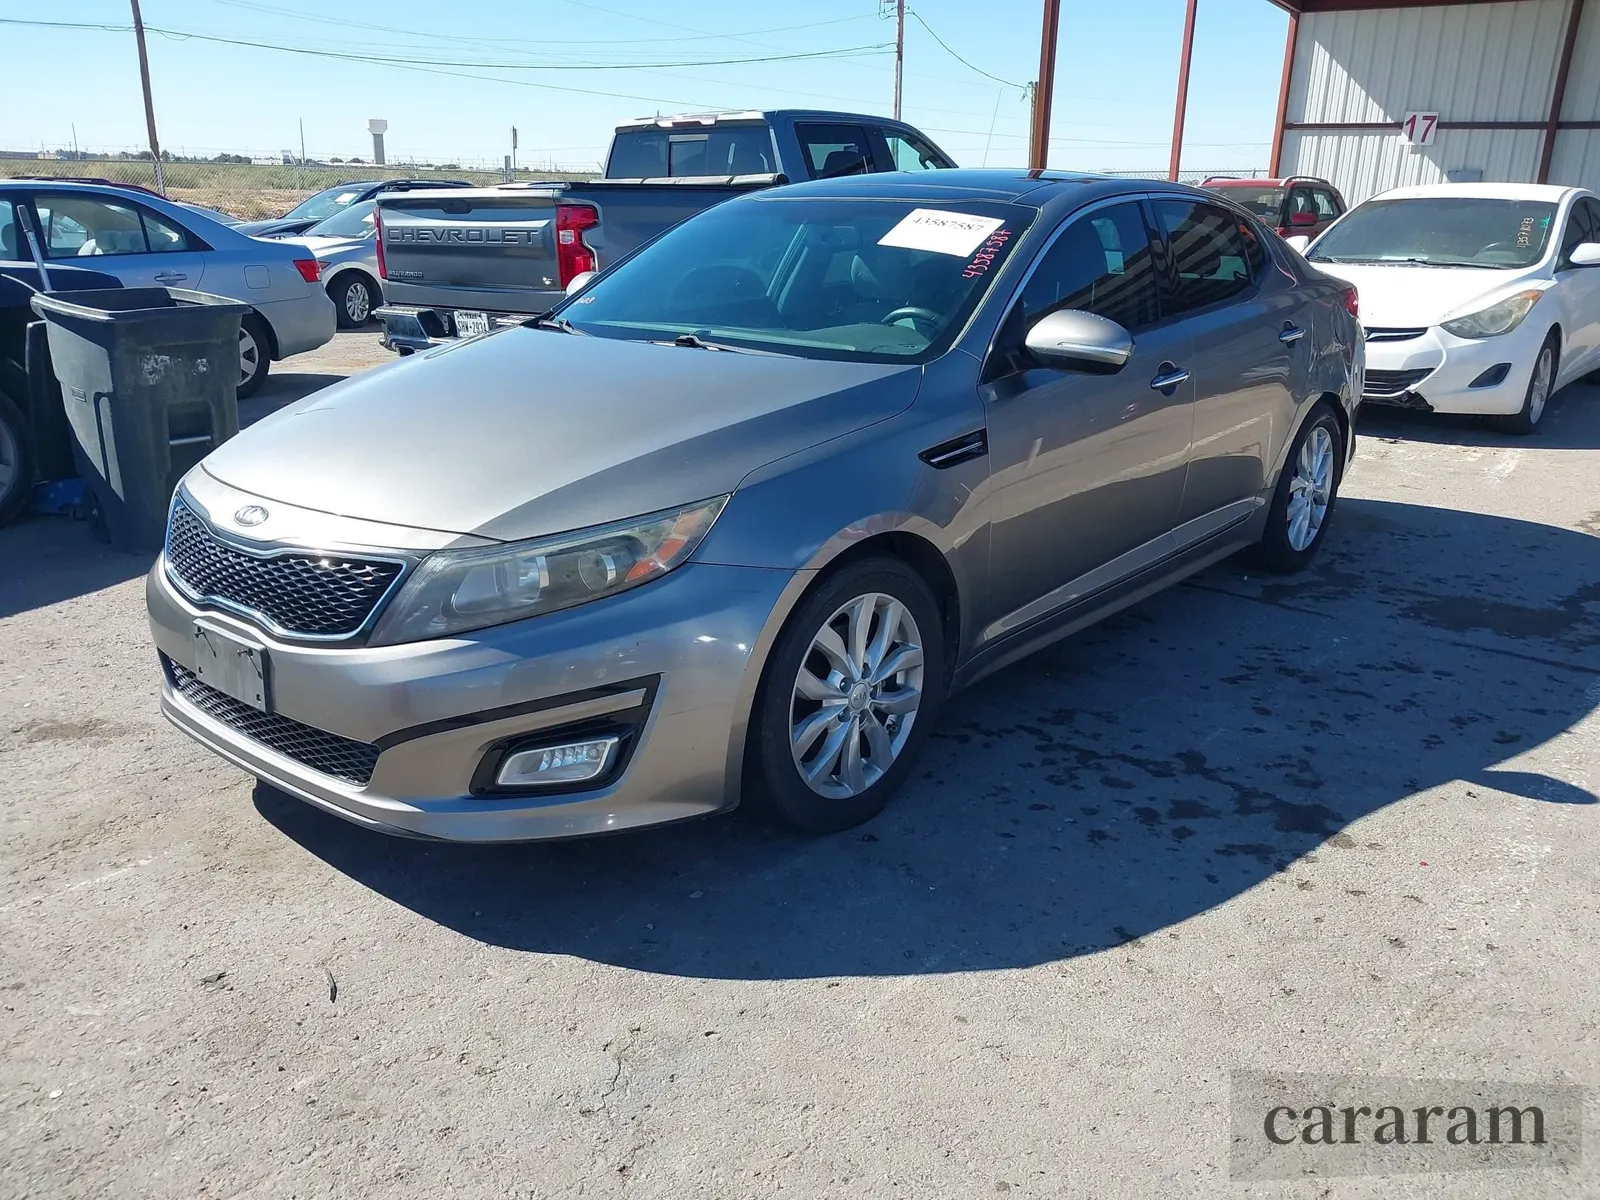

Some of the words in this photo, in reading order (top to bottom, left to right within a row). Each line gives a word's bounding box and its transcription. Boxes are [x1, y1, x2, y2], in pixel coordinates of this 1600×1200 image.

[1405, 114, 1437, 143] 17
[387, 228, 539, 245] CHEVROLET
[961, 229, 1012, 278] 43587587
